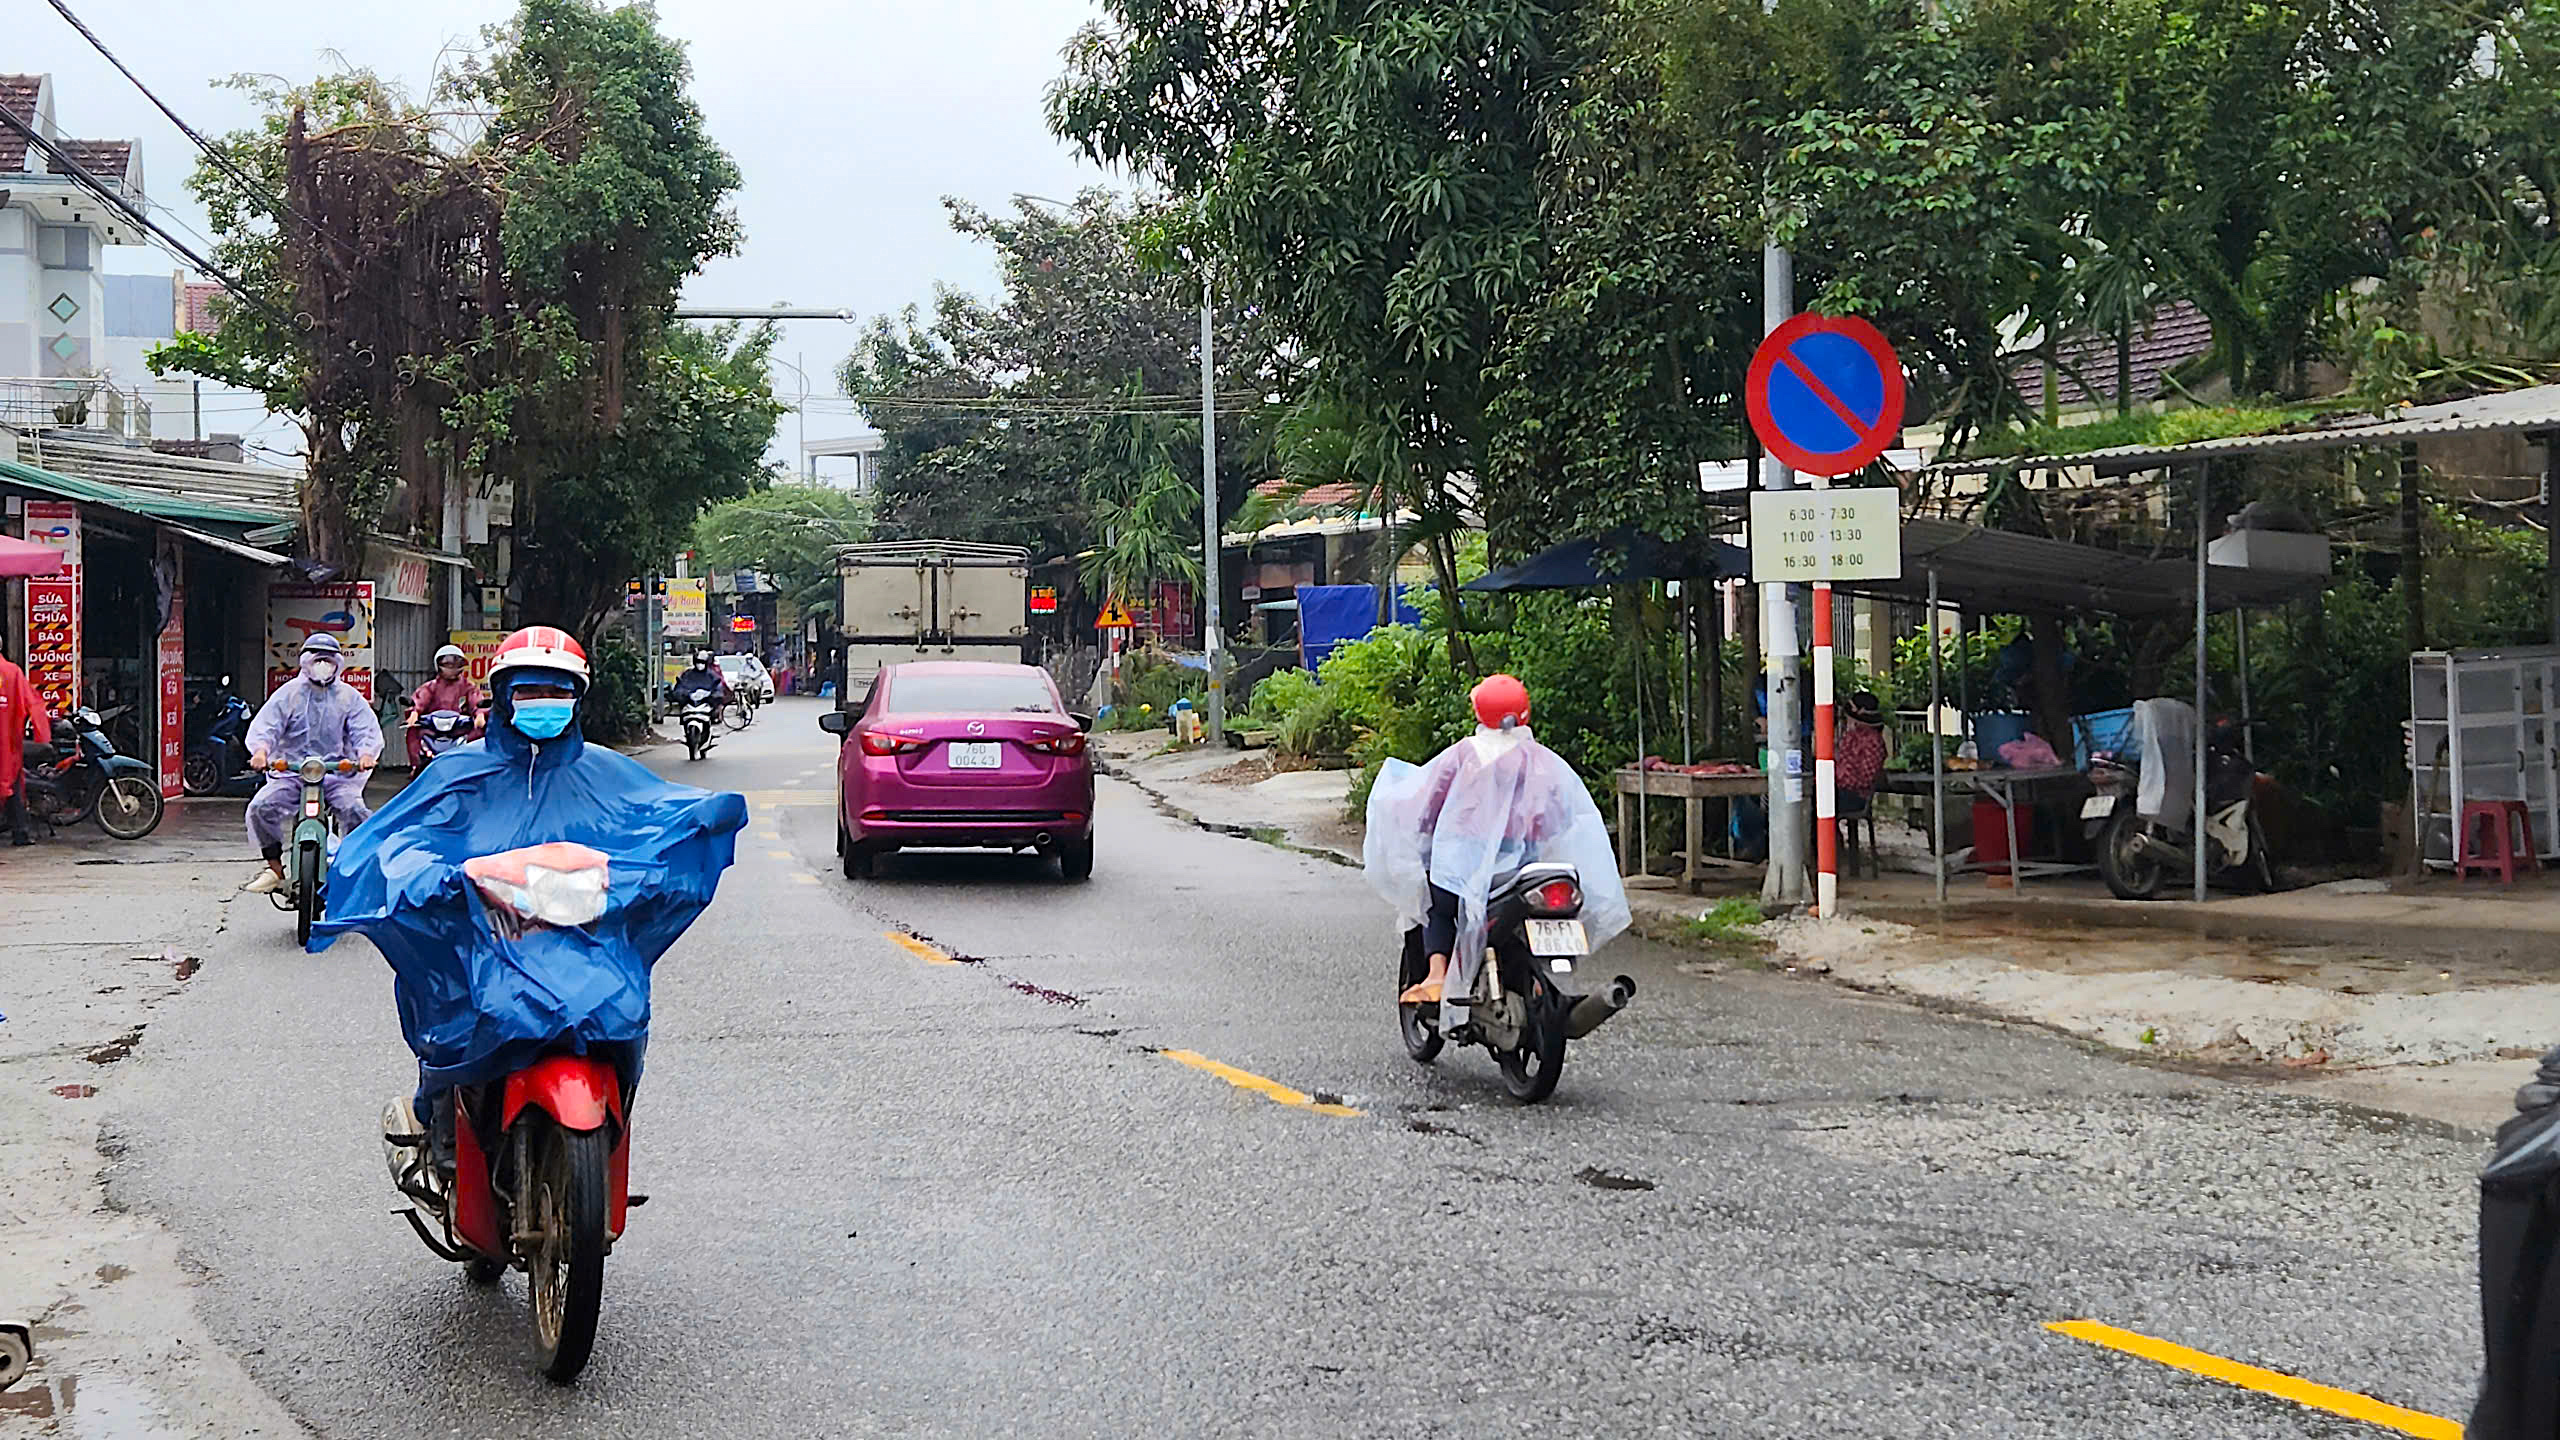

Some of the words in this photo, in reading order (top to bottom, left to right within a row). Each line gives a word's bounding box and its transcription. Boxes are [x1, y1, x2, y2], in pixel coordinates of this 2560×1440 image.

[1789, 508, 1815, 521] 6:30
[1830, 507, 1855, 520] 7:30
[1783, 530, 1814, 543] 11:00
[1830, 528, 1862, 541] 13:30
[1784, 555, 1816, 568] 16:30
[1832, 553, 1863, 566] 18:00
[44, 671, 60, 681] XE
[347, 672, 371, 683] BÌNH
[42, 690, 60, 700] GA
